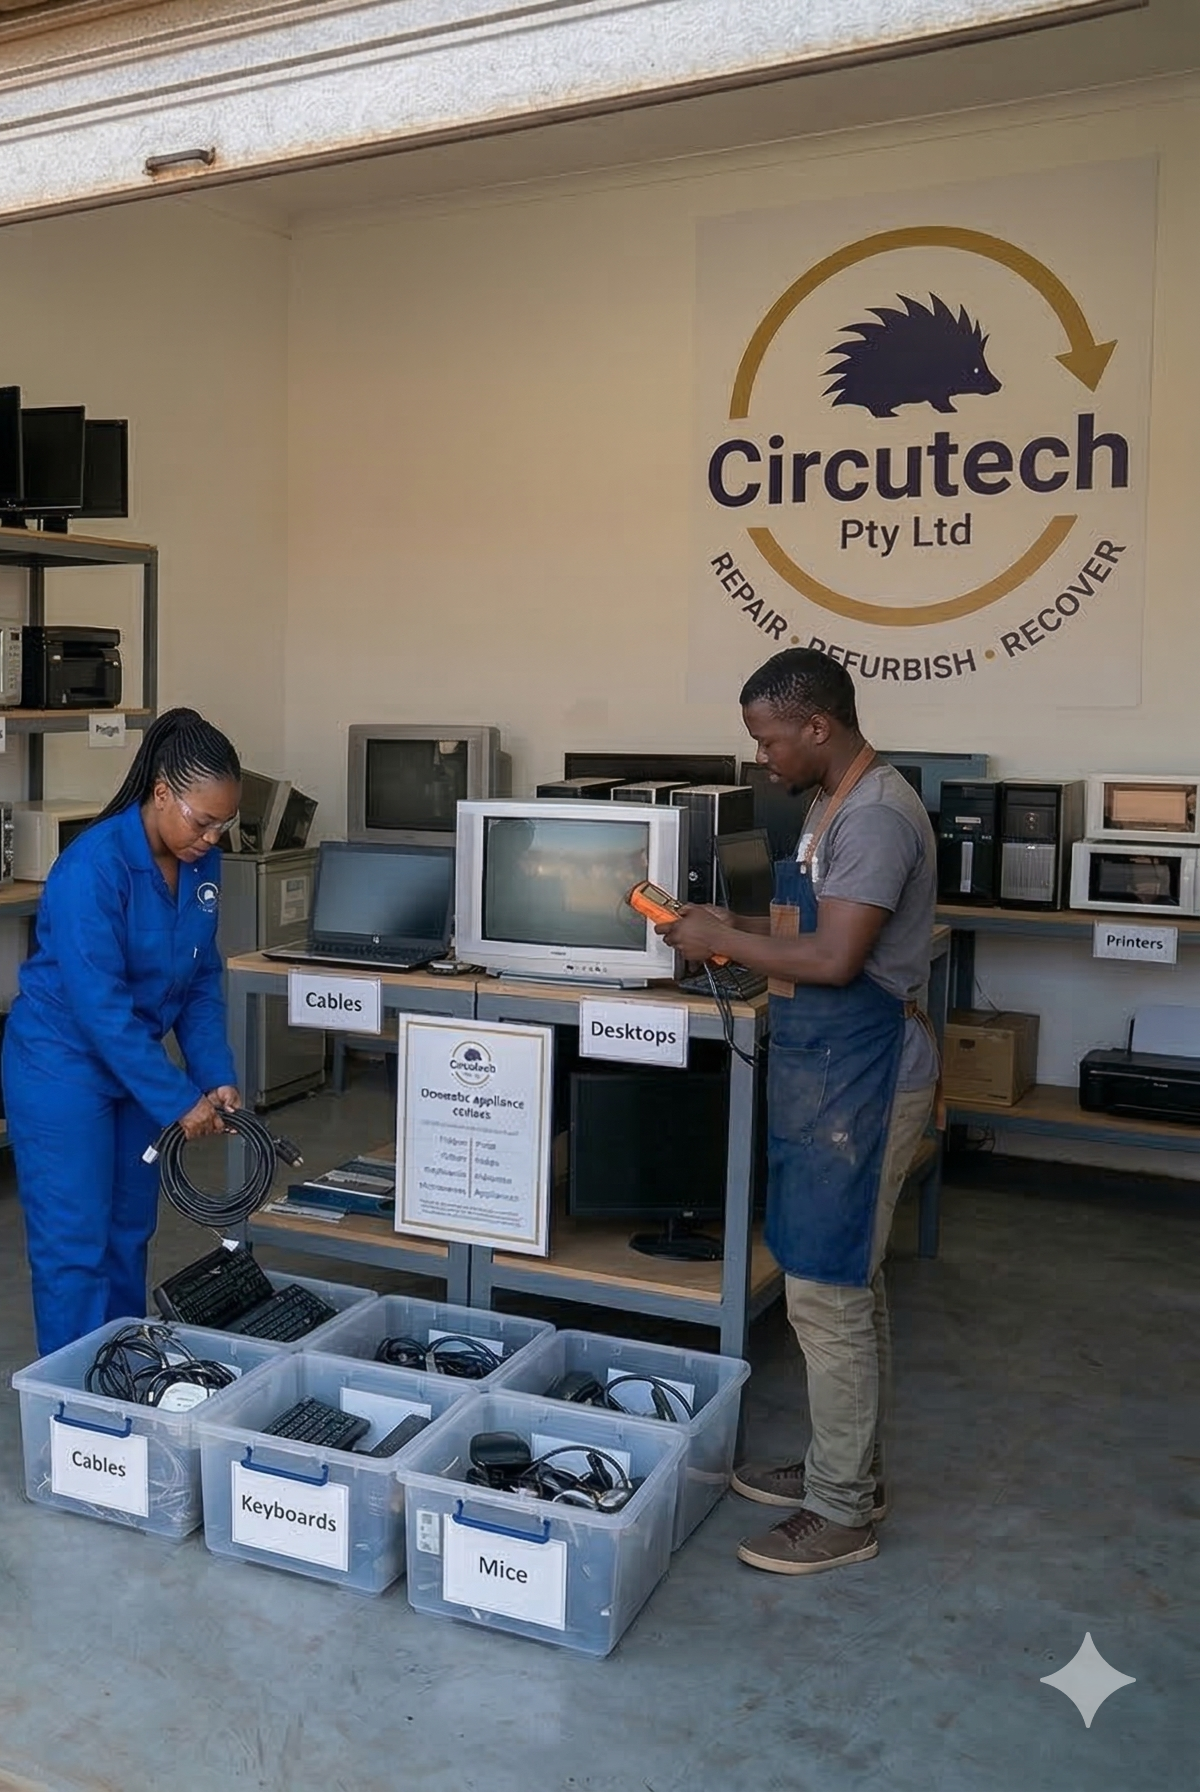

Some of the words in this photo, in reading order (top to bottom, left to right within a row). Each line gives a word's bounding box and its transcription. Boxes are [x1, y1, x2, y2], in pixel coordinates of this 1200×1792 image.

[707, 412, 1129, 508] Circutech
[840, 518, 899, 557] Pty
[913, 513, 972, 547] Ltd
[710, 551, 788, 642] REPAIR
[1001, 538, 1127, 659] RECOVER
[1107, 934, 1163, 949] Printers
[305, 991, 362, 1012] Cables
[591, 1021, 676, 1045] Desktops
[71, 1450, 126, 1477] Cables
[241, 1494, 336, 1531] Keyboards
[479, 1556, 528, 1583] Mice
